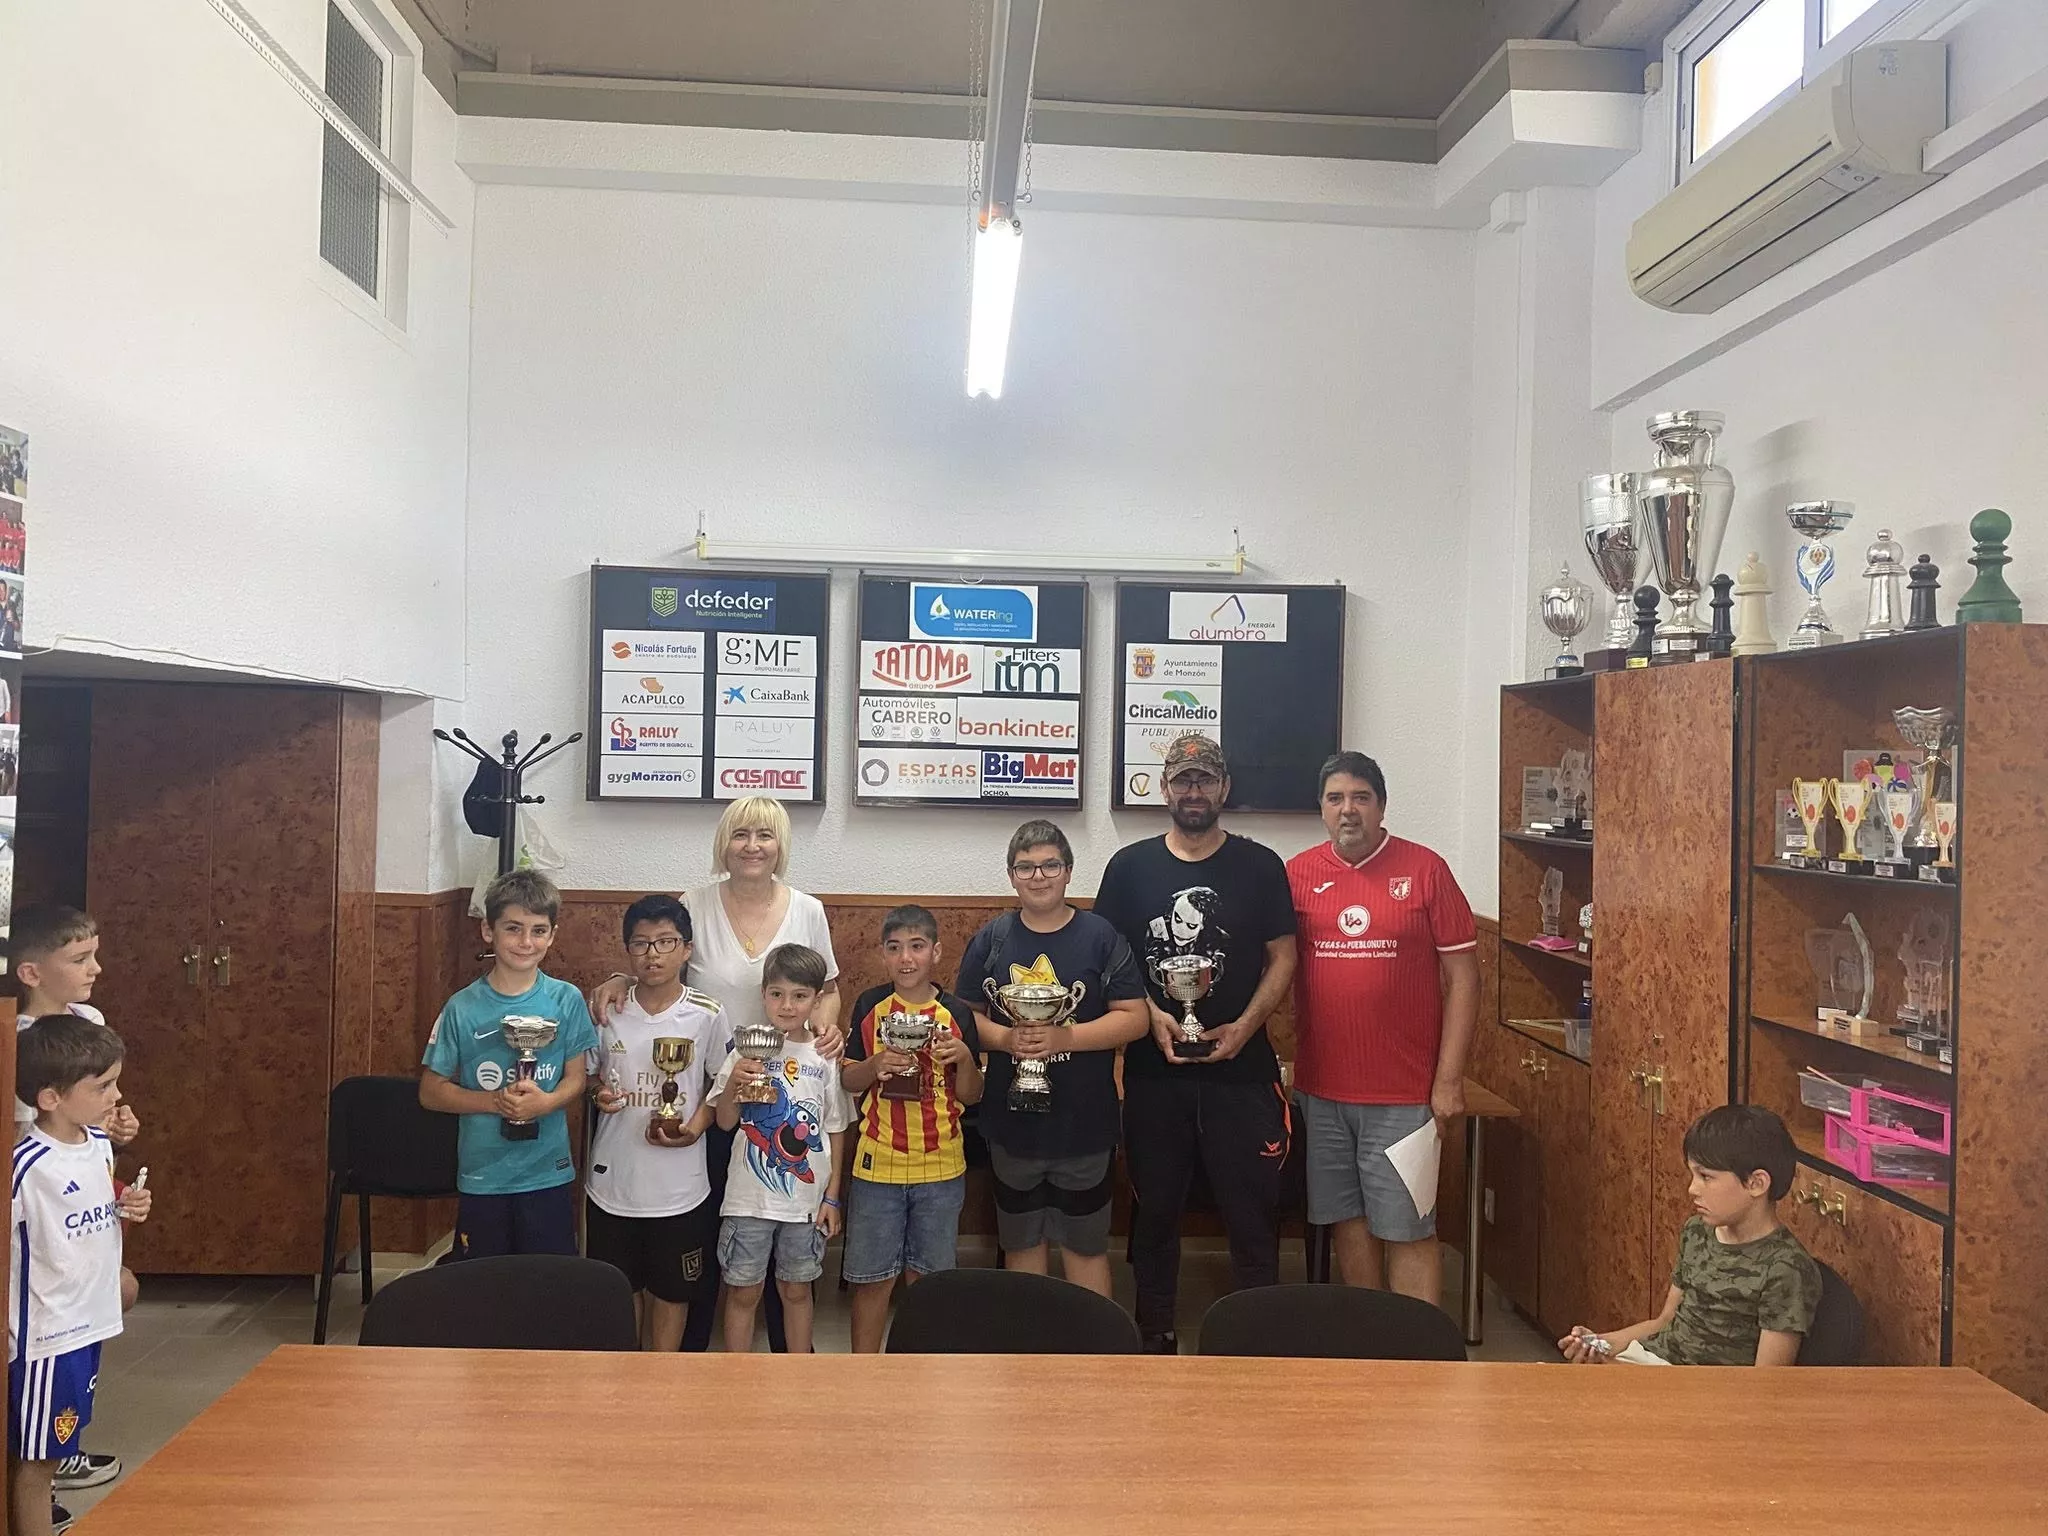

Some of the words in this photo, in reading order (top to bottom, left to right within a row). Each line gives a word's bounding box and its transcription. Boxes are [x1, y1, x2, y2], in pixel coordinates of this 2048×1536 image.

[685, 589, 774, 610] defeder
[727, 611, 763, 620] Inteligente
[953, 608, 1013, 622] WATERing
[1189, 625, 1266, 640] alumbra
[634, 643, 664, 653] Nicolás
[666, 644, 697, 654] Fortuño
[1012, 648, 1061, 662] Filters
[874, 643, 969, 682] TATOMA
[1163, 659, 1218, 668] Ayuntamiento
[994, 650, 1060, 693] itm
[1175, 669, 1206, 677] Monzón
[621, 694, 685, 705] ACAPULCO
[750, 687, 810, 702] CaixaBank
[862, 697, 936, 709] Automóviles
[871, 709, 952, 725] CABRERO
[1128, 703, 1218, 720] CincaMedio
[639, 726, 679, 739] RALUY
[734, 721, 796, 734] RALUY
[898, 763, 977, 778] ESPIAS
[983, 752, 1077, 783] BigMat
[1314, 941, 1340, 949] VEGAS
[1347, 940, 1398, 949] PUEBLONUEVO
[1315, 950, 1338, 958] Sociedad
[1338, 951, 1372, 959] Cooperativa
[1373, 950, 1397, 958] Limitada
[506, 1063, 556, 1083] Stify
[637, 1071, 660, 1088] Fly
